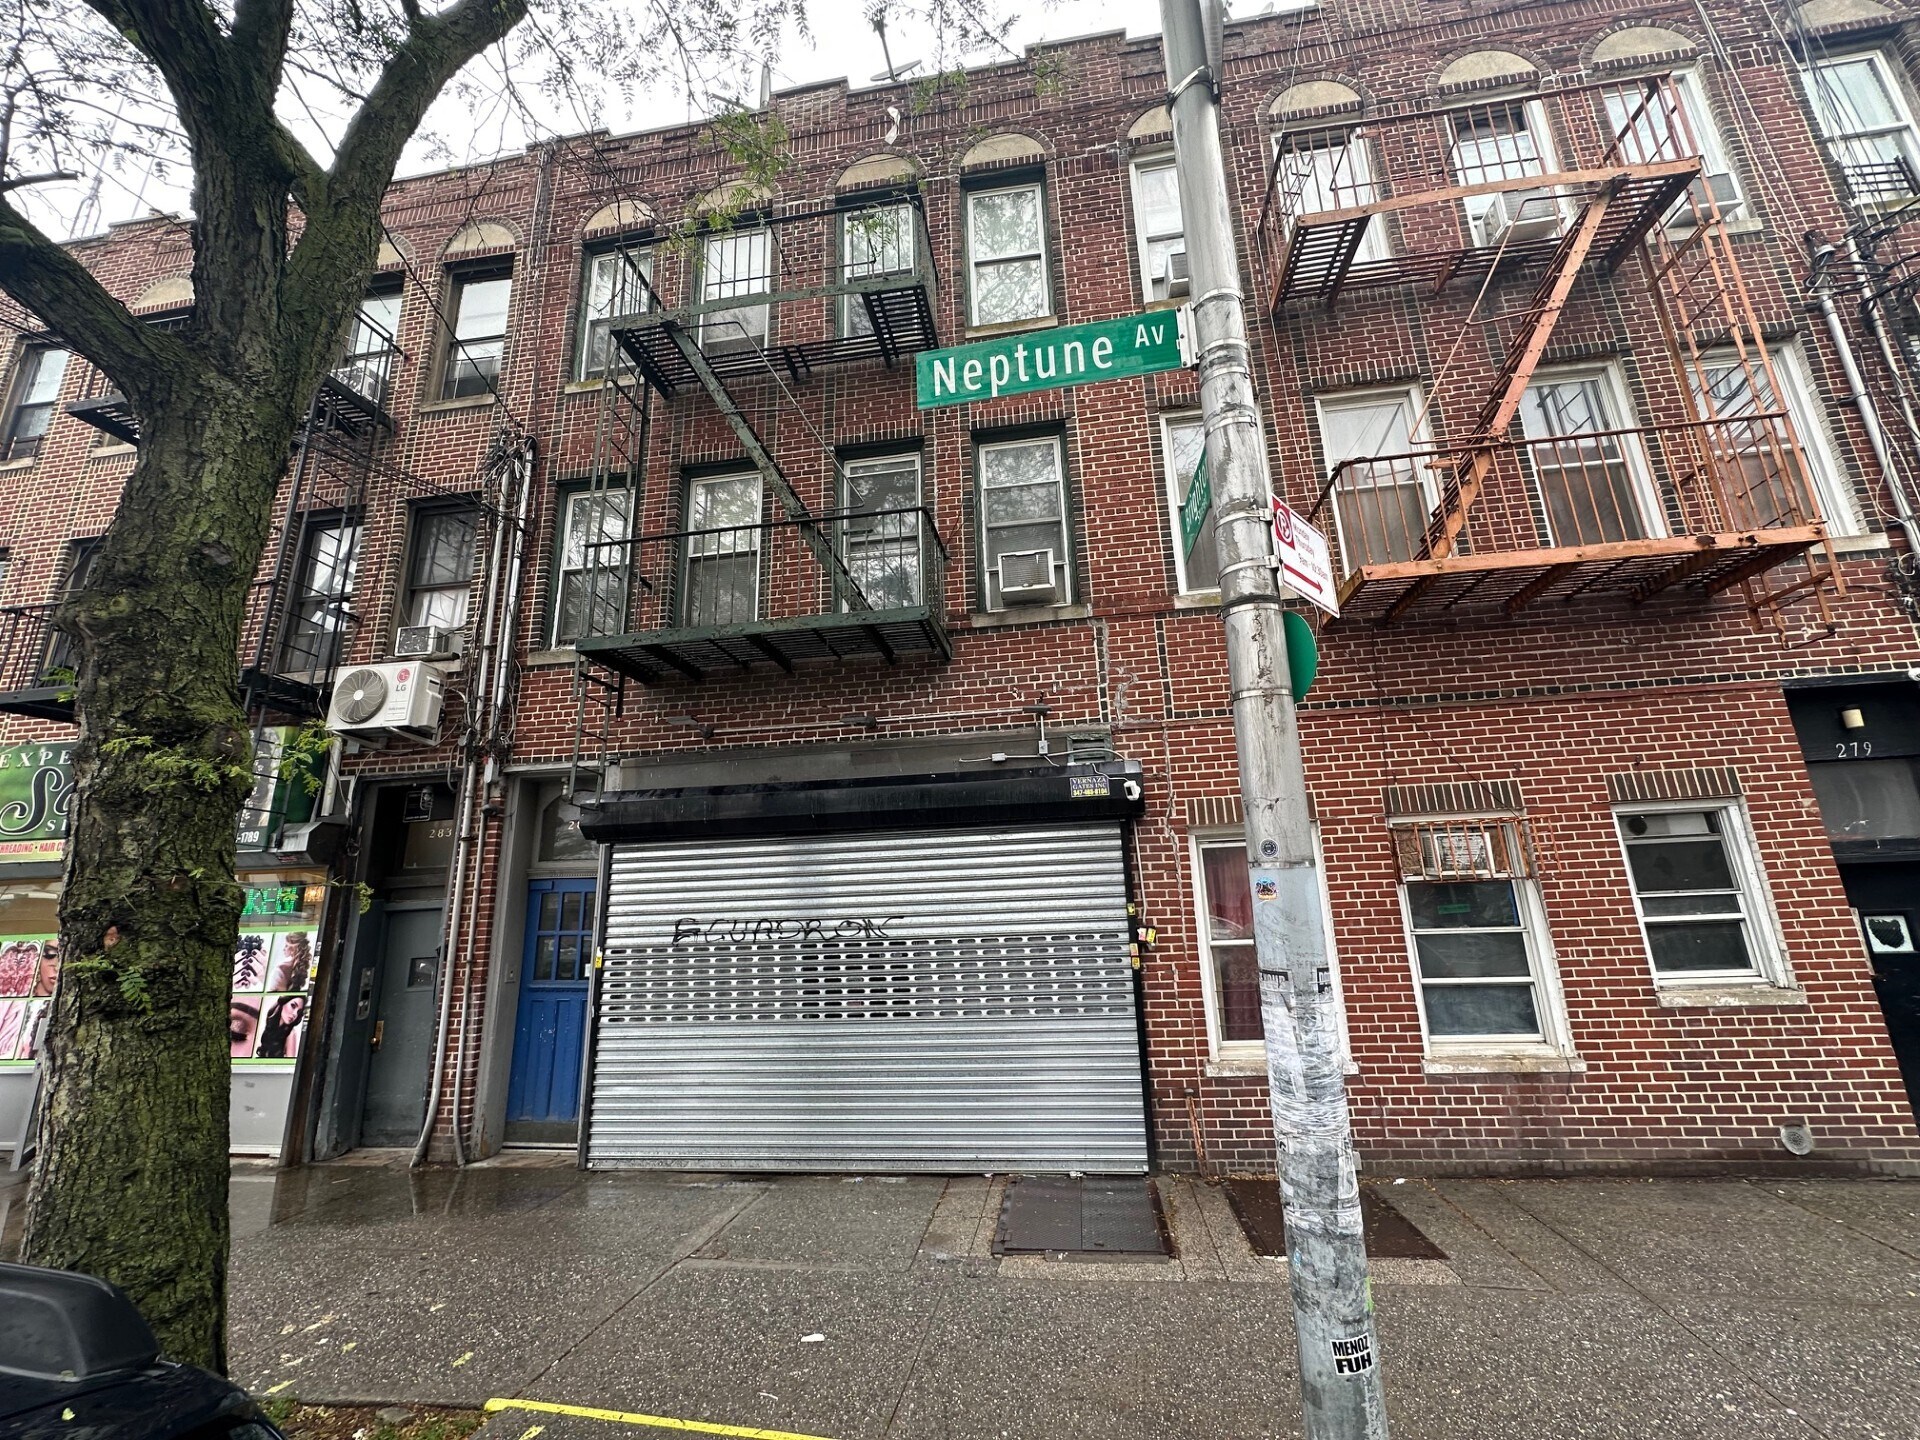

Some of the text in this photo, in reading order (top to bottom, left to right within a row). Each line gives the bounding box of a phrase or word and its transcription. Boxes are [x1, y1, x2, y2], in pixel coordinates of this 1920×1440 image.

[933, 323, 1164, 397] Neptune Av
[395, 684, 407, 692] LG
[0, 749, 72, 768] EXPE
[429, 827, 452, 838] 283
[1331, 1335, 1369, 1356] MENOZ
[1335, 1351, 1372, 1374] FUH
